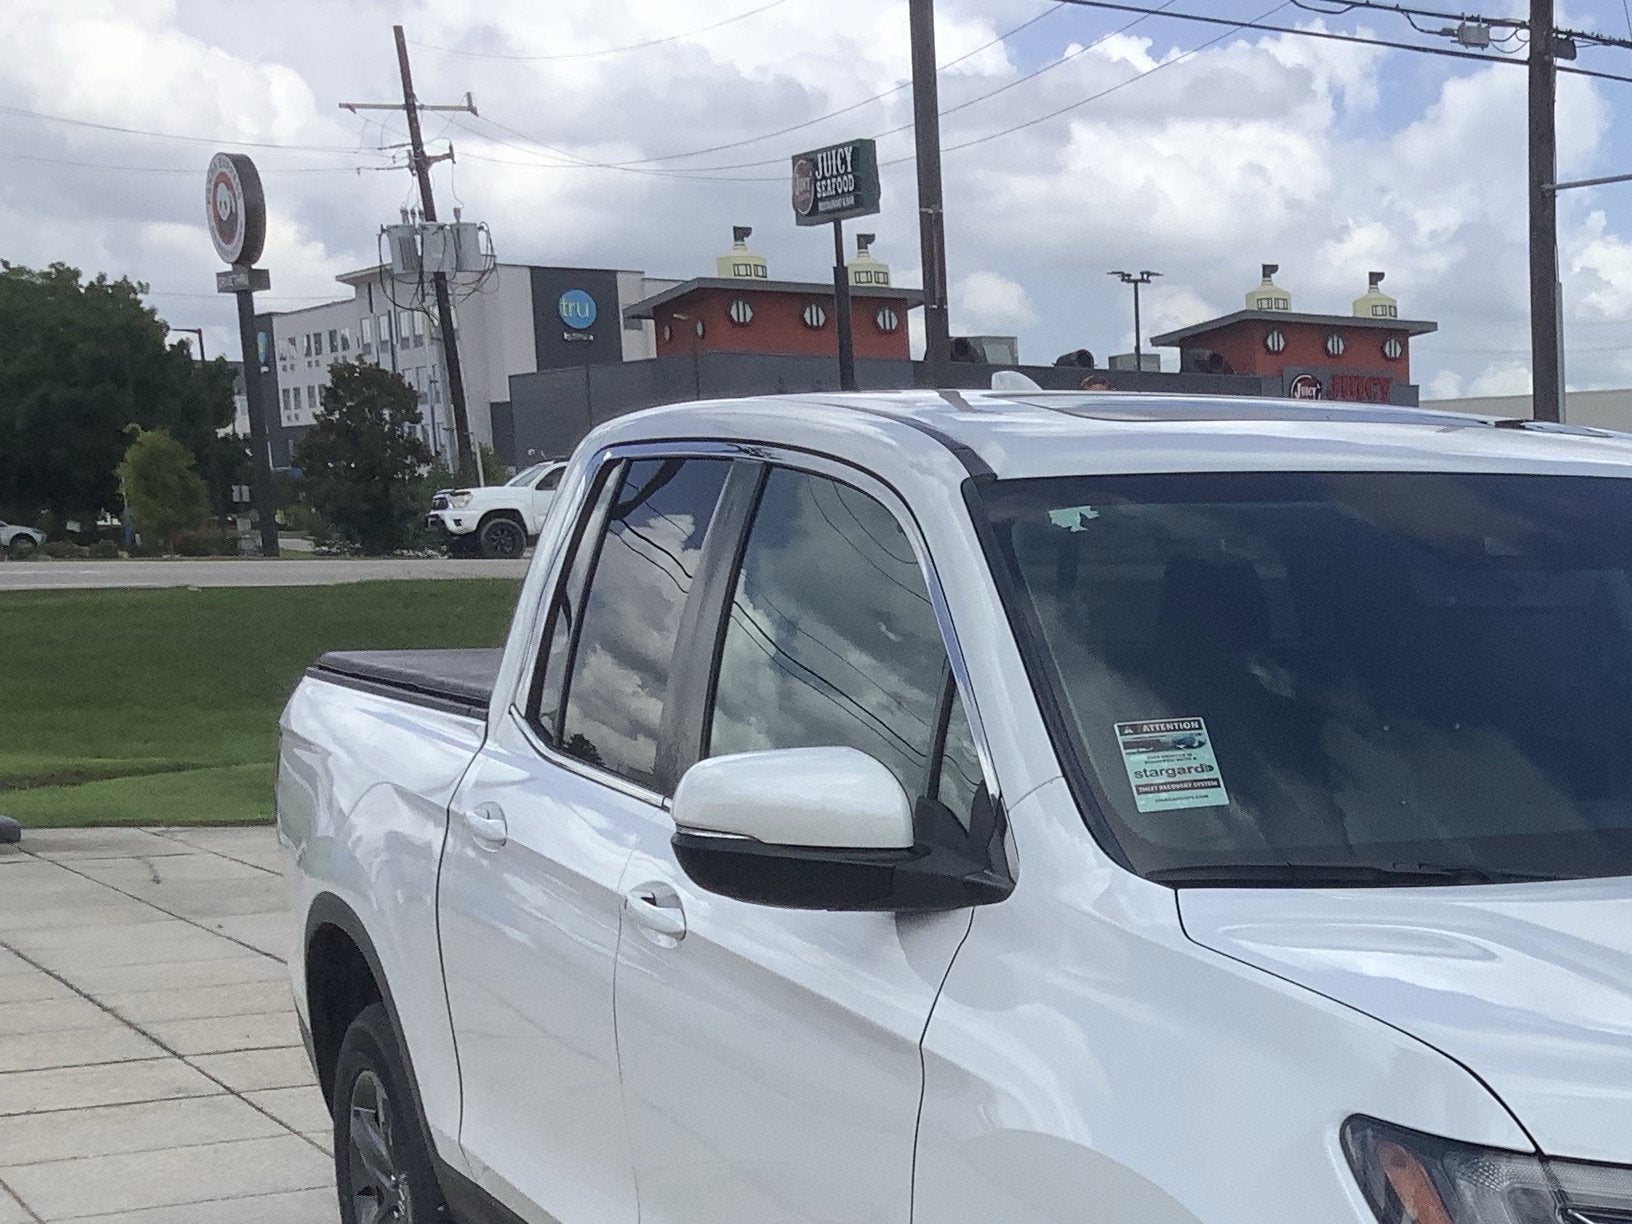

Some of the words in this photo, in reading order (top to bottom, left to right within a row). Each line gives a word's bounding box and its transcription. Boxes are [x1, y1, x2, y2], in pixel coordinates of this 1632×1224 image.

[815, 145, 853, 179] JUICY
[815, 173, 855, 198] SEAFOOD
[560, 297, 589, 318] tru
[1294, 382, 1317, 400] JUICY
[1142, 721, 1199, 733] ATTENTION
[1134, 763, 1204, 779] stargard
